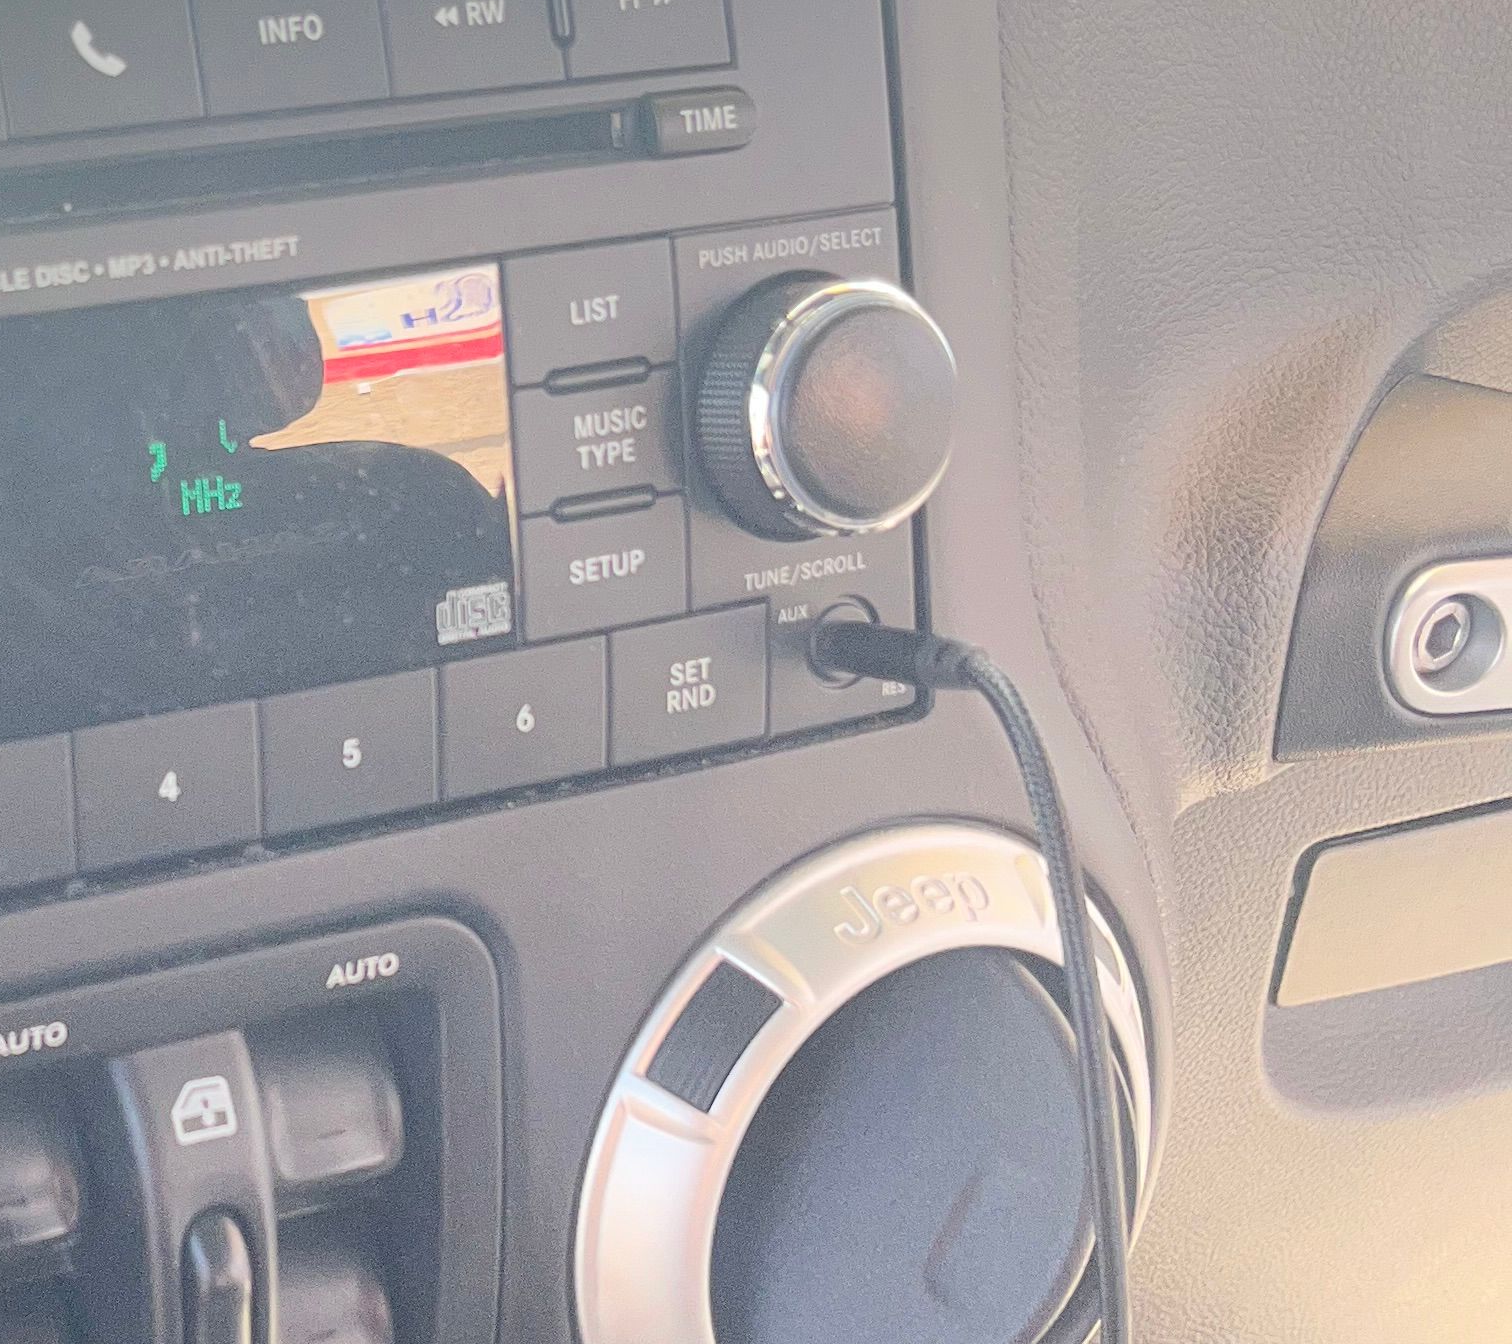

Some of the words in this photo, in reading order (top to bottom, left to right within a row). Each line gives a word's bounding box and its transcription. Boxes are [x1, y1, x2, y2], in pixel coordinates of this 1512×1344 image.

[258, 13, 324, 44] INFO
[680, 104, 738, 134] TIME
[34, 260, 90, 288] DISC
[108, 253, 156, 278] MP3
[173, 235, 299, 271] ANTI-THEFT
[698, 245, 748, 268] PUSH
[753, 226, 882, 260] AUDIO/SELECT
[570, 294, 619, 325] LIST
[573, 406, 647, 440] MUSIC
[576, 440, 635, 470] TYPE
[180, 475, 243, 516] MHz
[569, 548, 645, 585] SETUP
[744, 551, 867, 591] TUNE/SCROLL
[778, 604, 808, 622] AUX
[670, 658, 712, 687] SET
[667, 684, 716, 713] RND
[516, 704, 535, 733] 6
[343, 738, 362, 768] 5
[158, 771, 180, 801] 4
[834, 874, 989, 942] Jeep
[326, 952, 400, 988] AUTO
